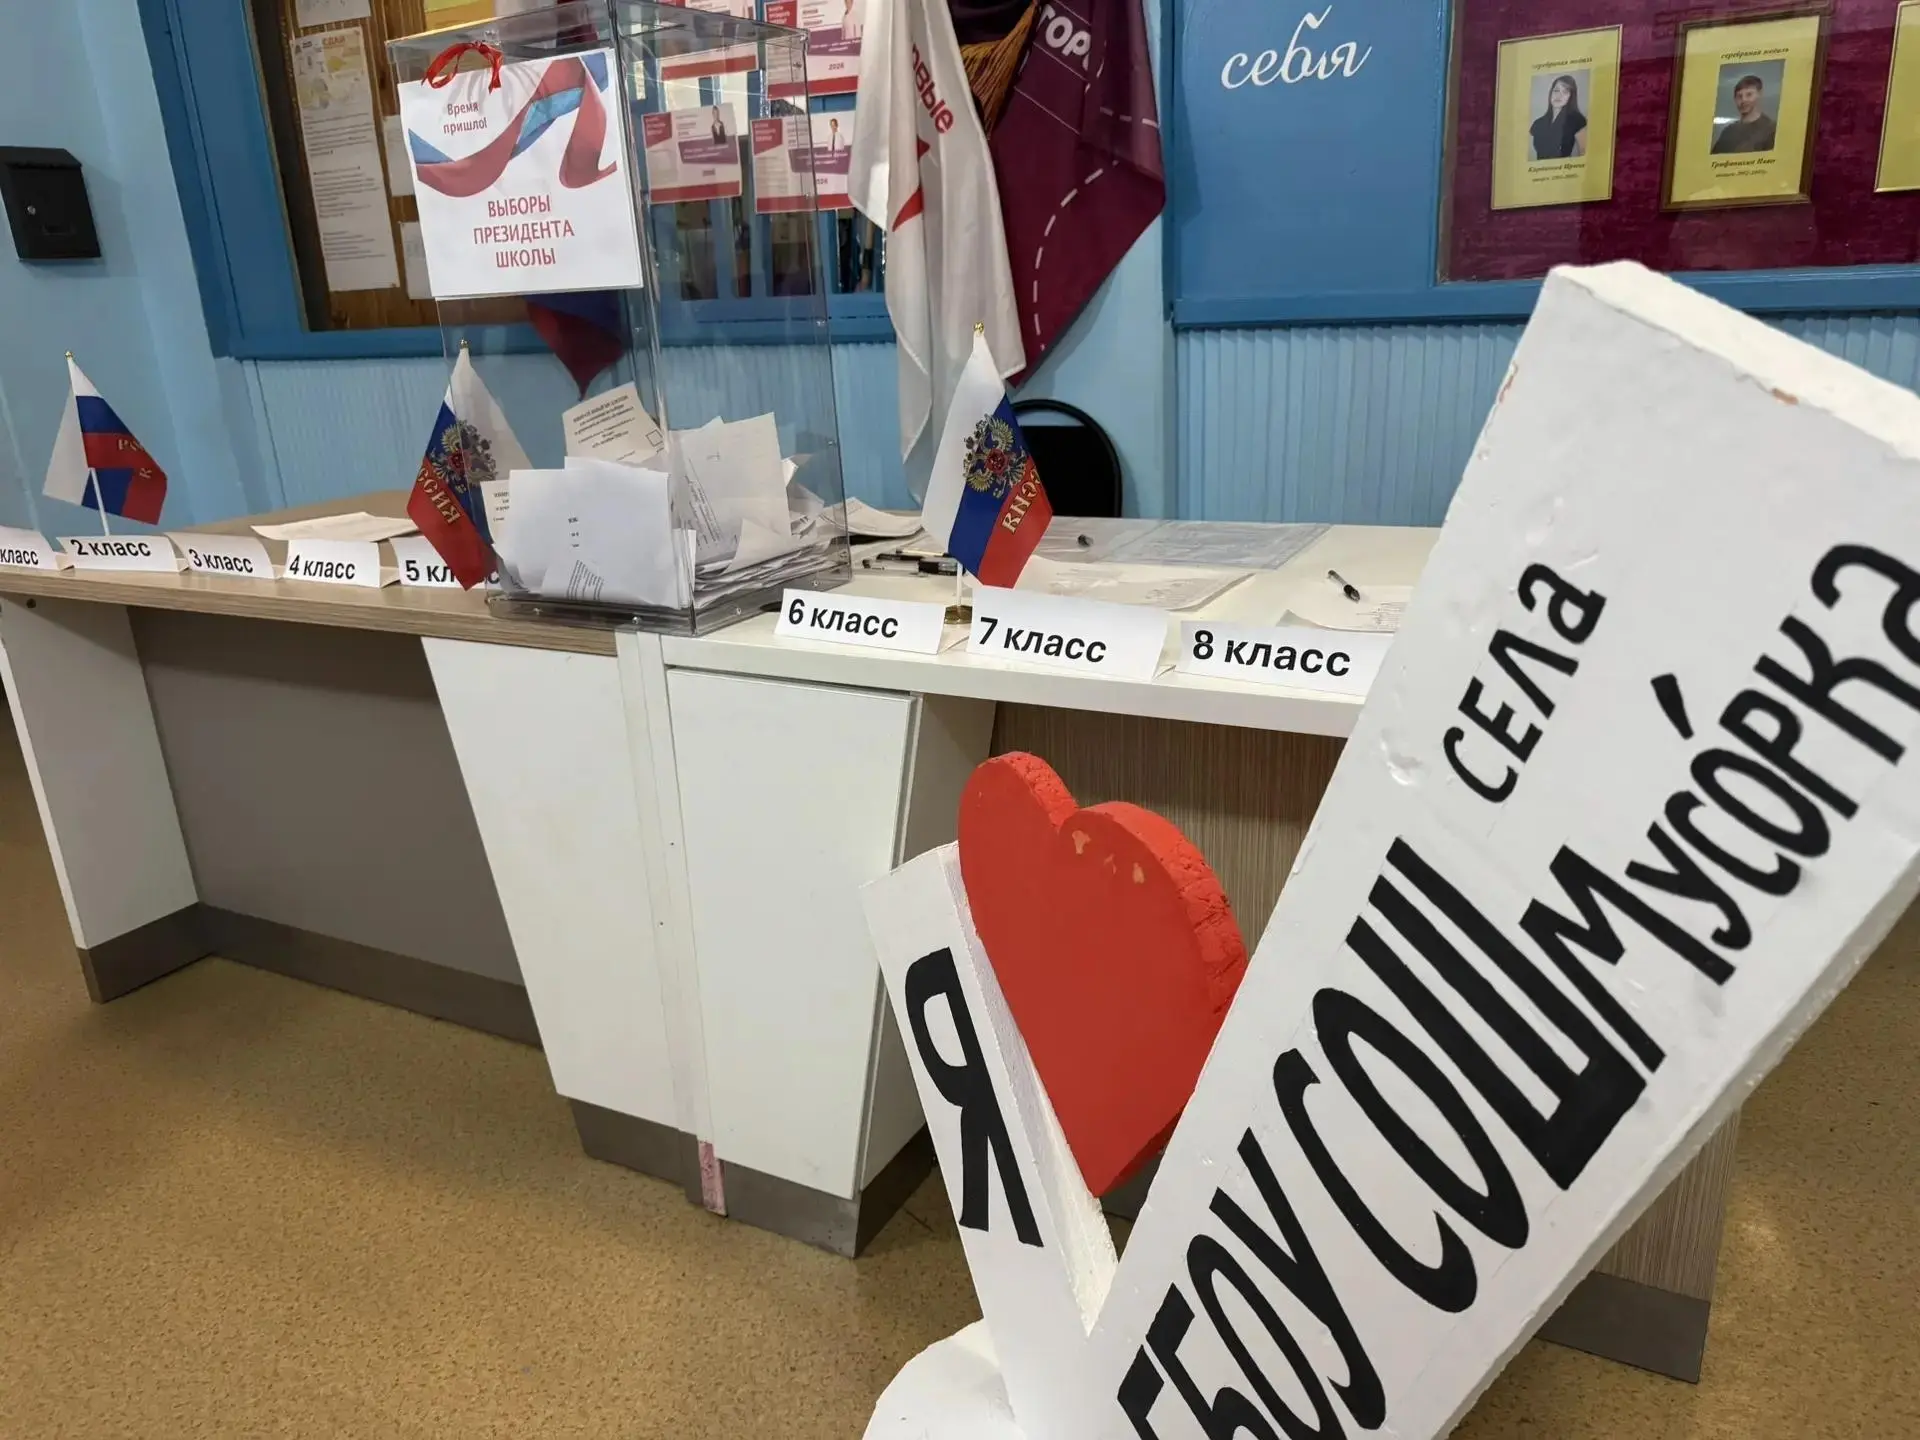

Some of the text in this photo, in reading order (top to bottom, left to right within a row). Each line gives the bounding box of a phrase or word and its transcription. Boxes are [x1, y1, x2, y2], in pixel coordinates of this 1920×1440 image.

[1221, 5, 1373, 90] себя
[447, 101, 479, 118] Время
[443, 116, 488, 136] пришло!
[487, 195, 551, 218] ВЫБОРЫ
[473, 219, 576, 245] ПРЕЗИДЕНТА
[495, 247, 557, 269] ШКОЛЫ
[70, 539, 152, 557] 2 класс
[188, 549, 254, 573] 3 класс
[289, 554, 356, 580] 4 класс
[405, 559, 420, 581] 5
[788, 598, 899, 638] 6 класс
[979, 616, 1107, 663] 7 класс
[1193, 629, 1351, 677] 8 класс
[1273, 836, 1647, 1314] СОШ
[904, 946, 1044, 1248] Я
